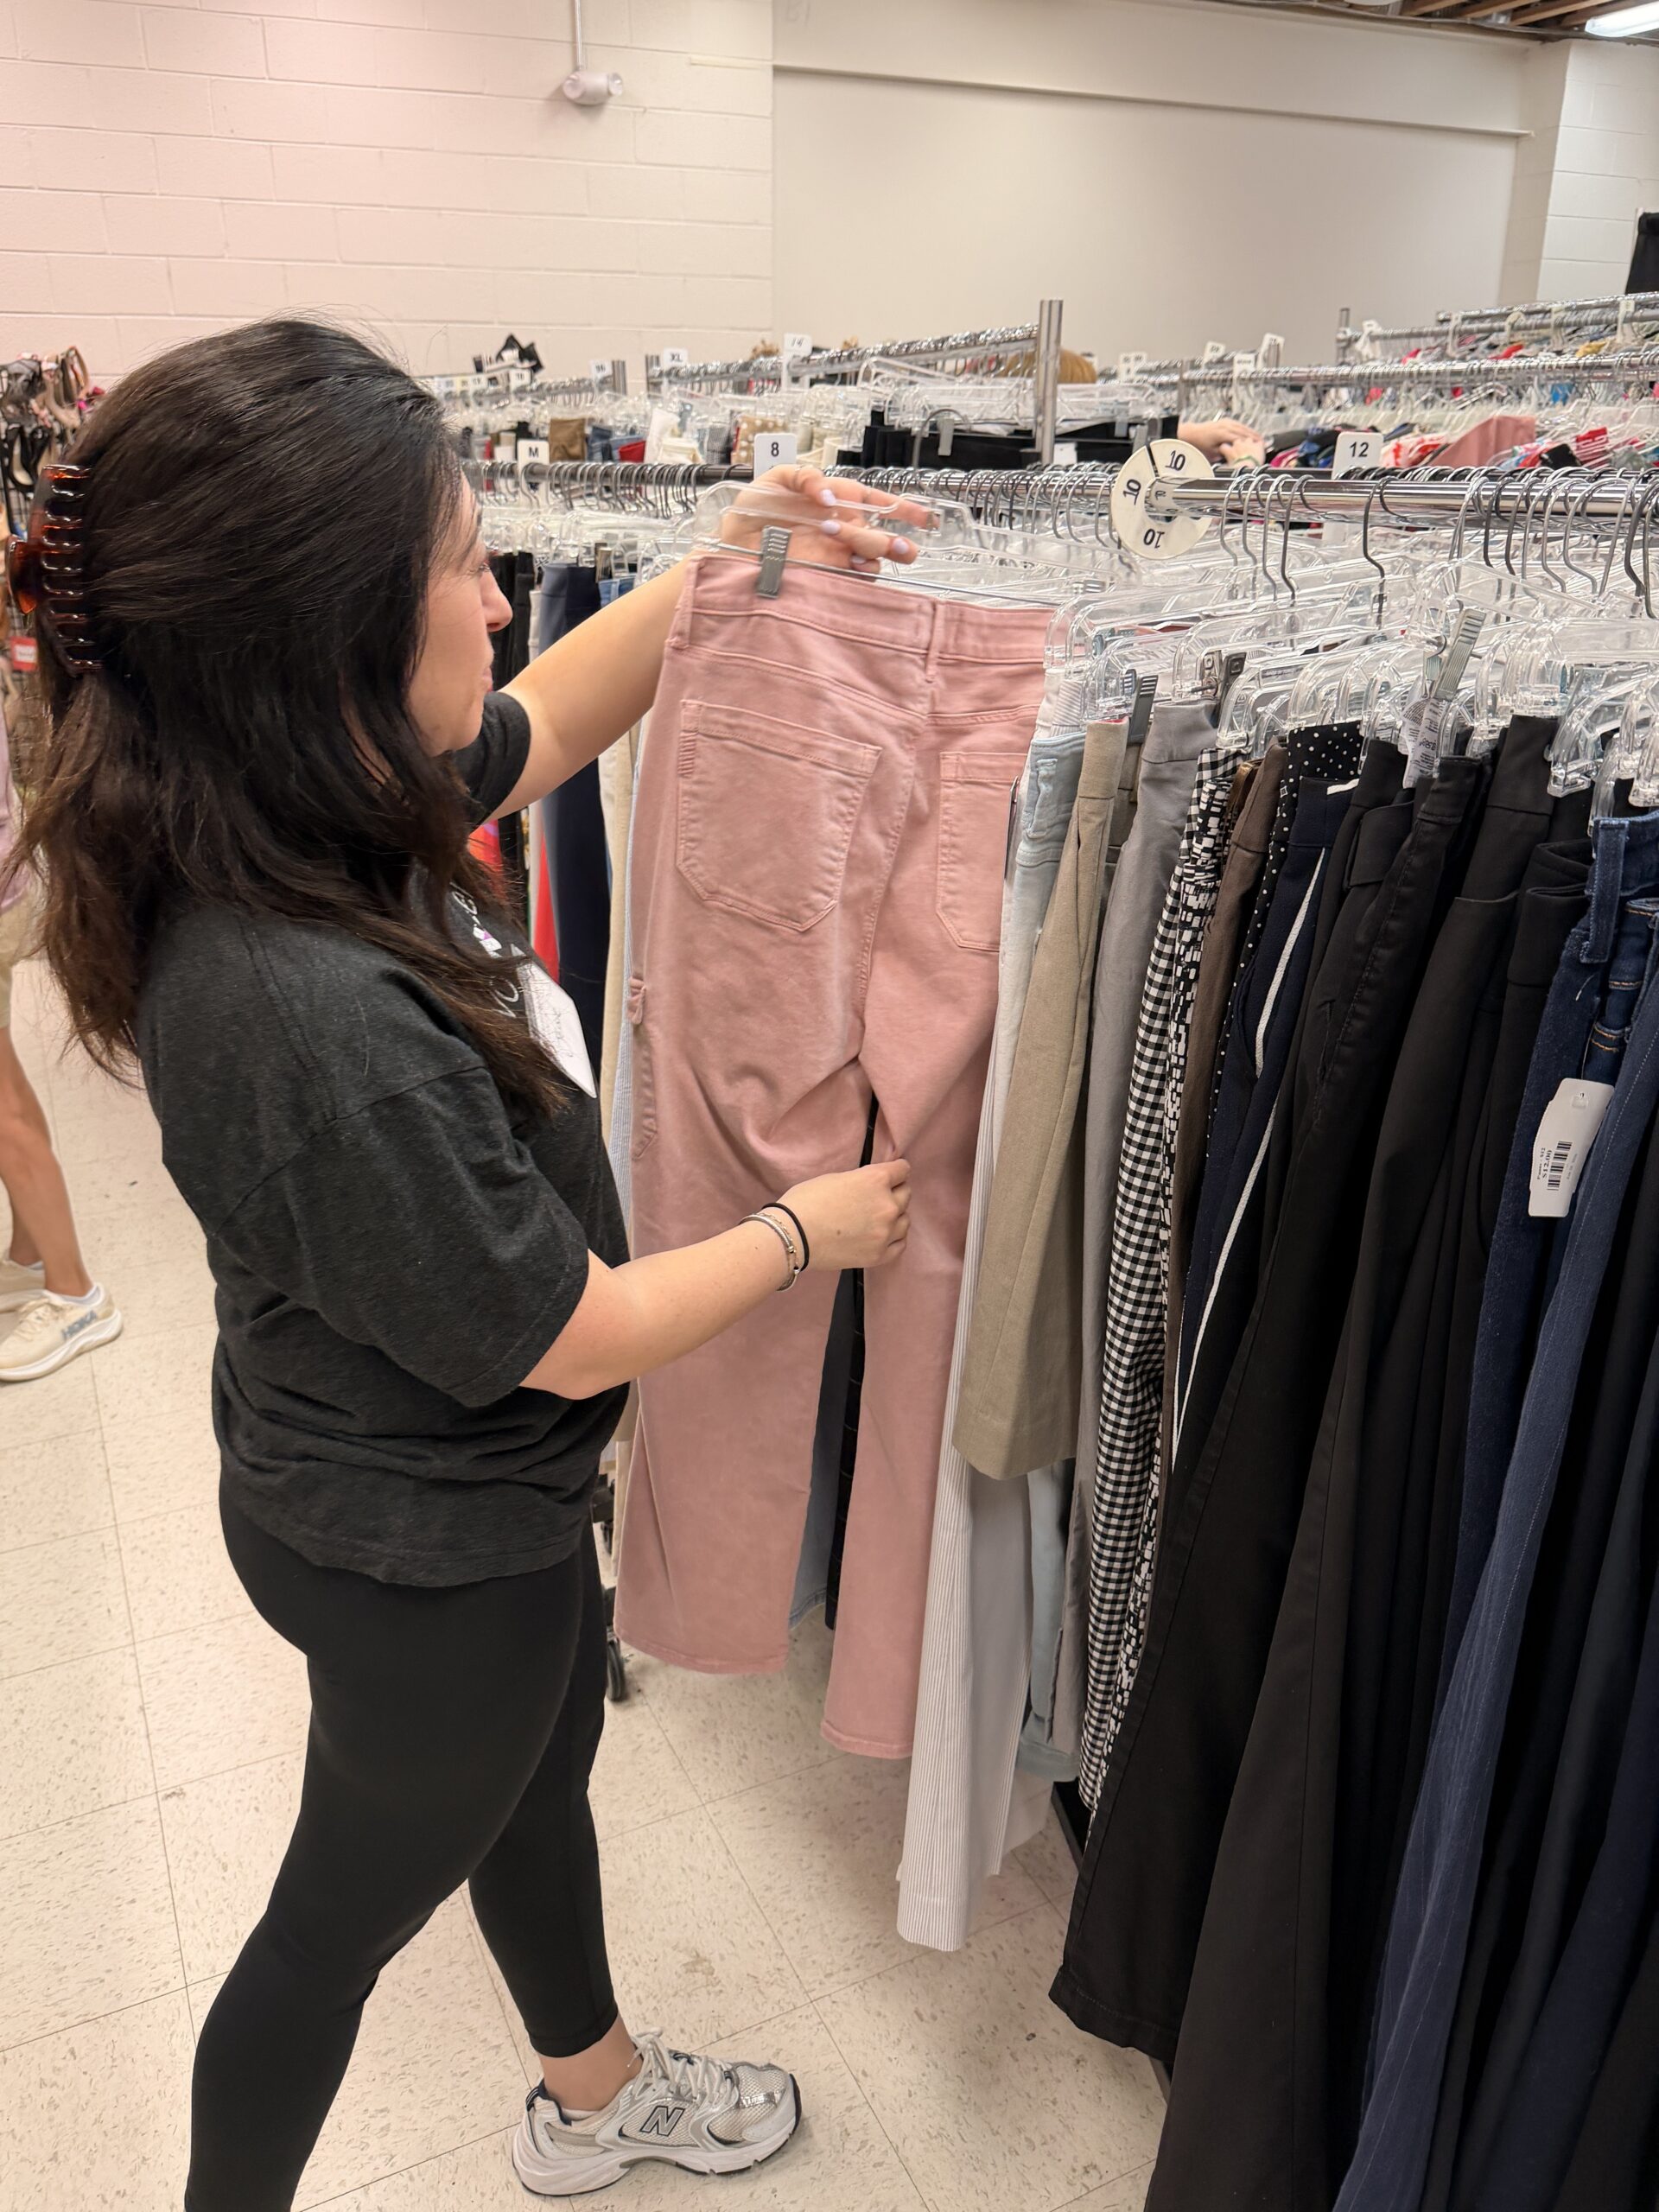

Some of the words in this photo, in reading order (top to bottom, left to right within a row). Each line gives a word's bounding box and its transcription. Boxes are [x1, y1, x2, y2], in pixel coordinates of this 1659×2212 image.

[528, 446, 539, 459] M
[771, 442, 779, 457] 8
[1164, 449, 1186, 472] 10
[1349, 442, 1370, 458] 12
[1122, 478, 1142, 505] 10
[1142, 528, 1165, 550] 10
[639, 2105, 686, 2137] N
